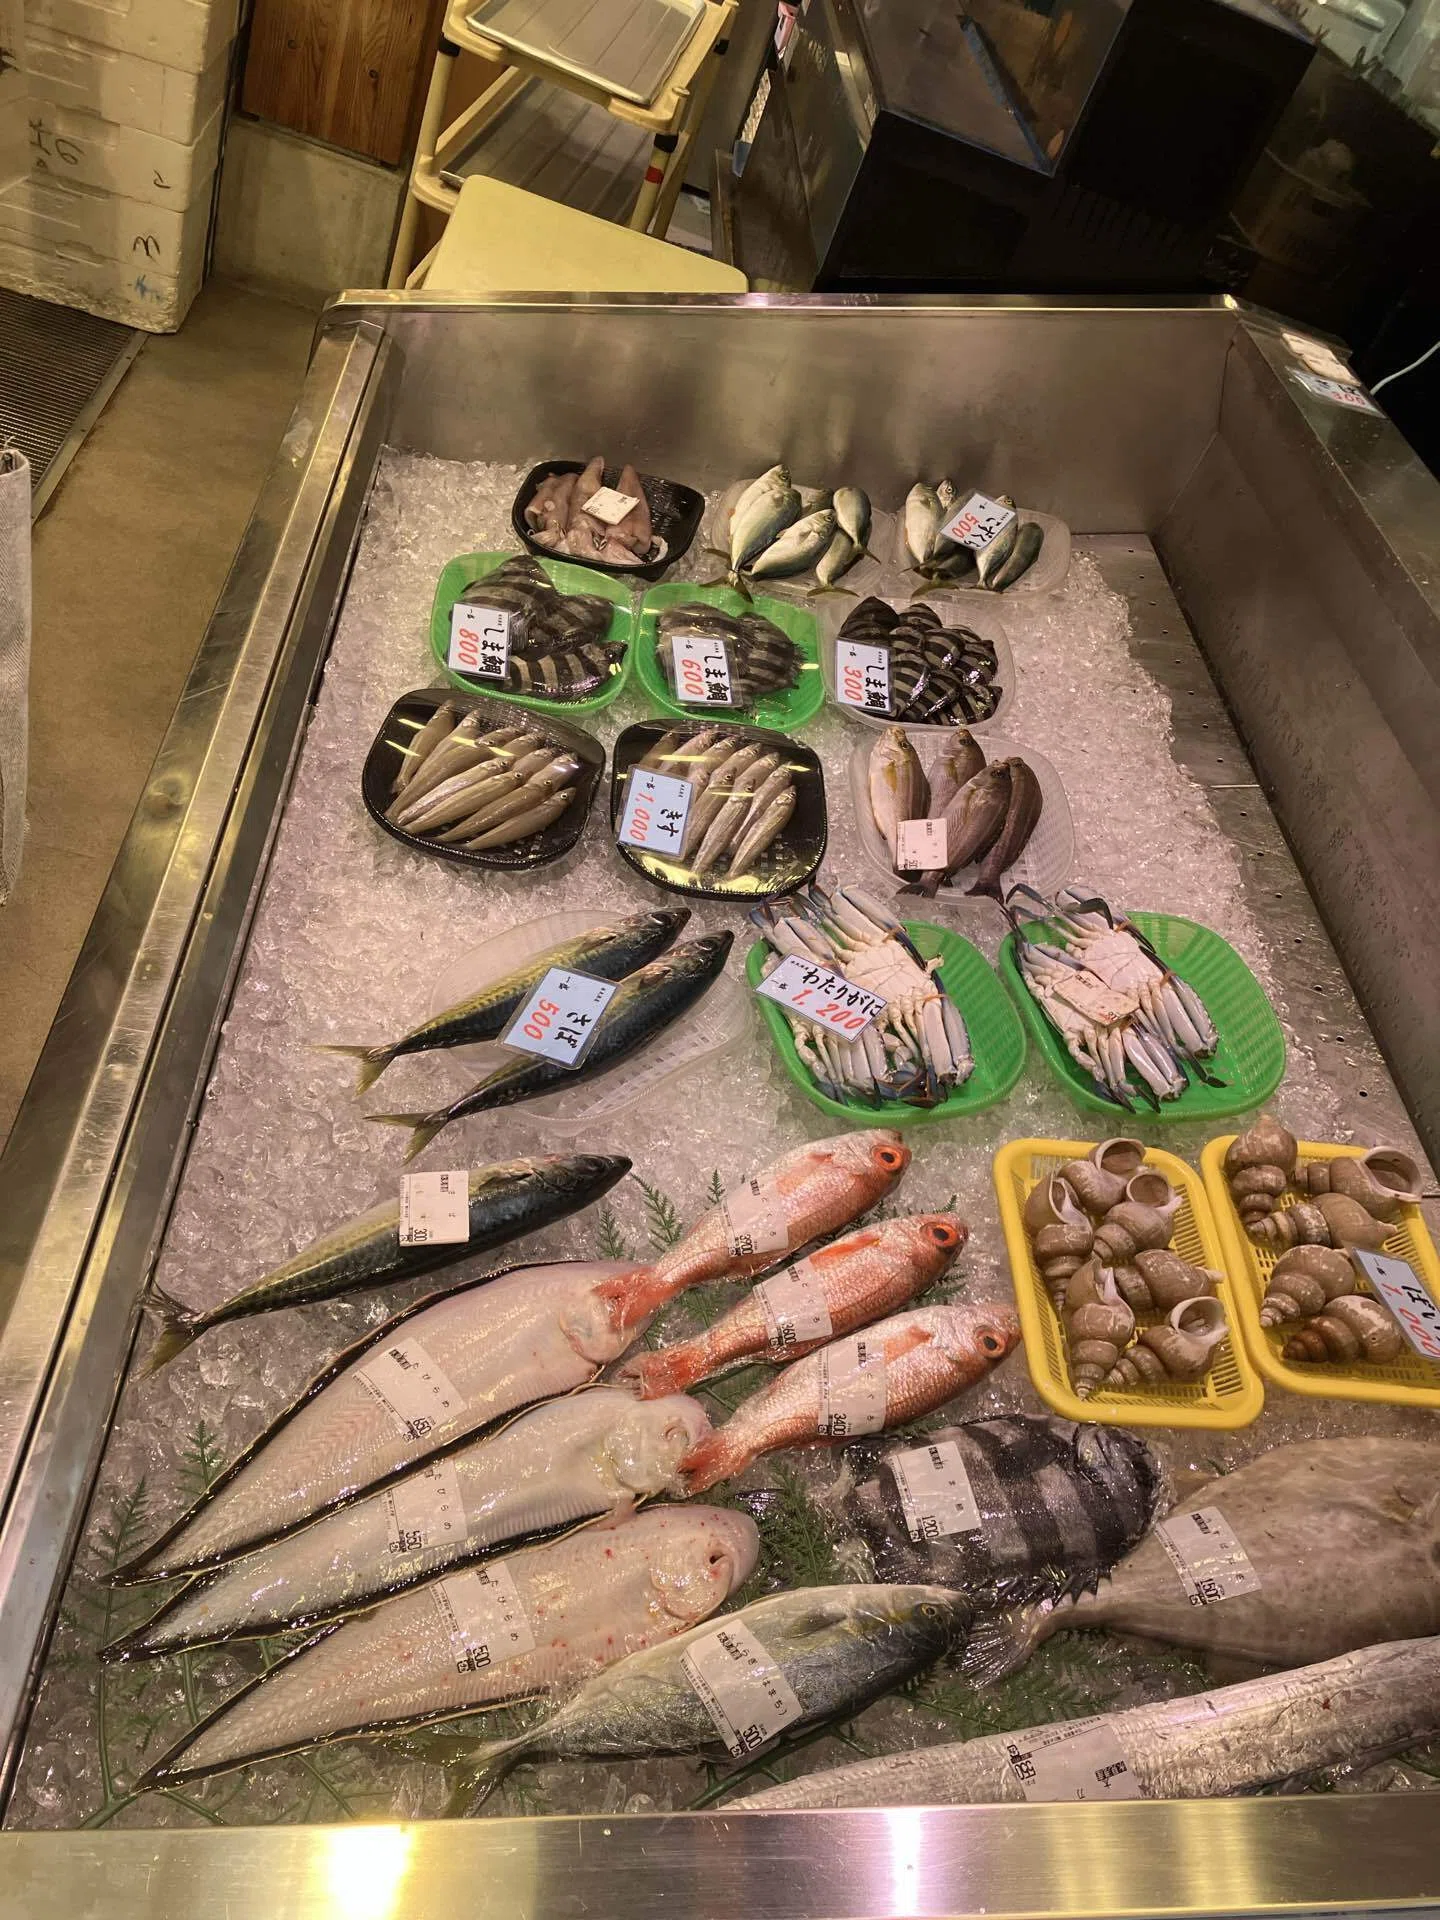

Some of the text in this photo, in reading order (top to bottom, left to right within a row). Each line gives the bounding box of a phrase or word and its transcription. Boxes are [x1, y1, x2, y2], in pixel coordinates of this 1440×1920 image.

[952, 512, 978, 538] 500
[457, 628, 480, 666] 800
[479, 628, 504, 674] しま鯛
[682, 658, 703, 696] 600
[704, 656, 728, 701] しま鯛
[844, 666, 864, 702] 300
[865, 665, 886, 708] しま鯛
[657, 809, 682, 837] きす
[803, 967, 886, 1018] わたりがに
[523, 1000, 559, 1040] 500
[554, 1011, 592, 1050] さば
[413, 1228, 426, 1241] 300
[738, 1233, 754, 1255] 3900
[412, 1415, 432, 1435] 650
[832, 1413, 846, 1435] 3400
[921, 1514, 939, 1538] 1200
[471, 1645, 491, 1668] 500
[743, 1724, 763, 1749] 500
[1014, 1760, 1036, 1780] 550
